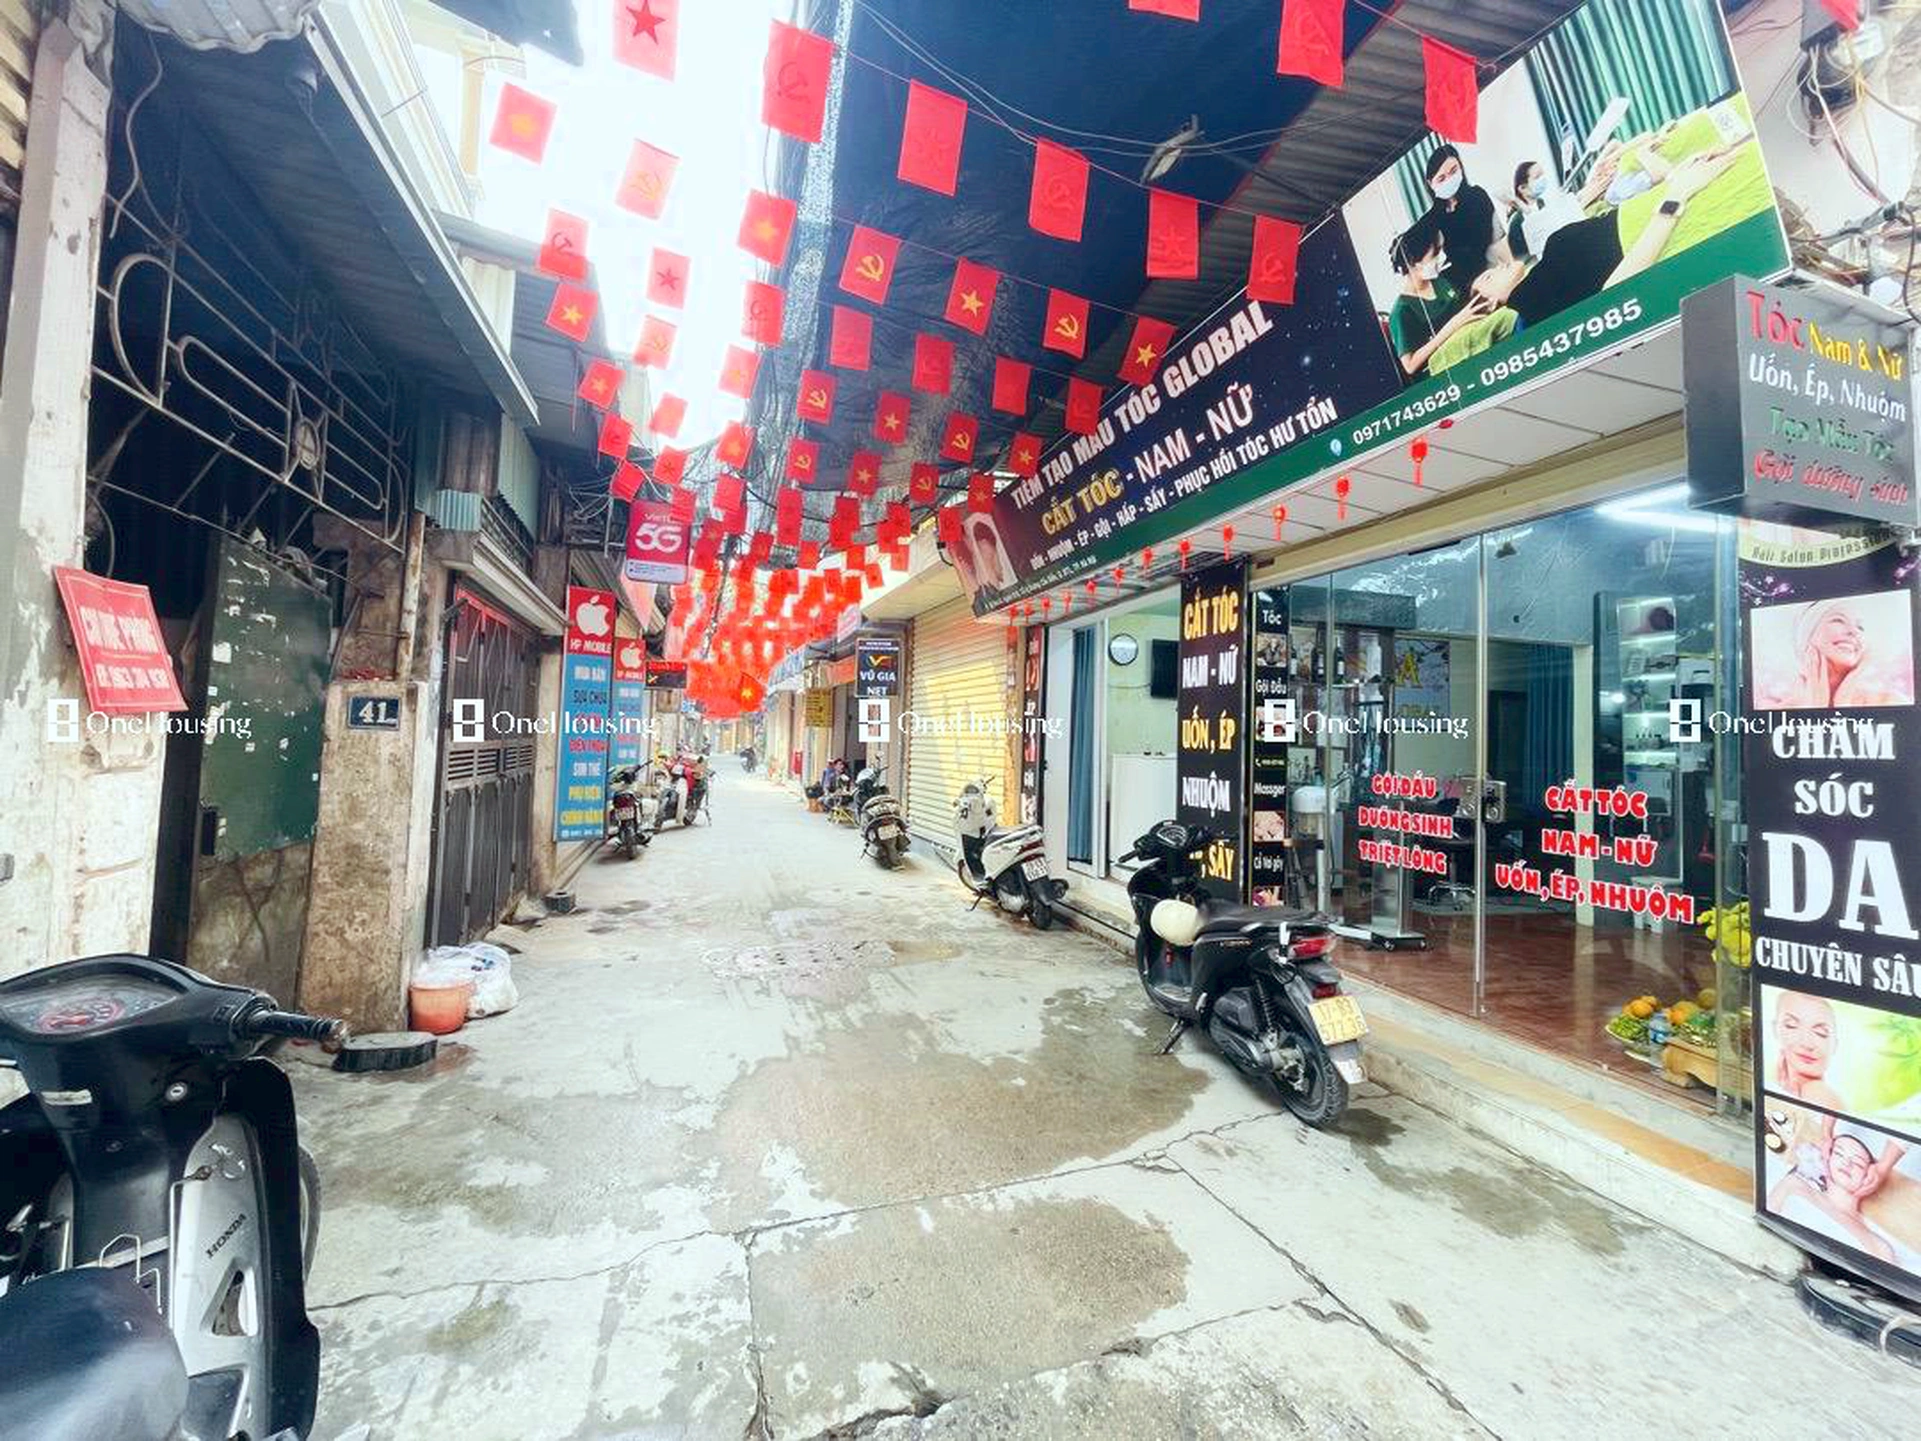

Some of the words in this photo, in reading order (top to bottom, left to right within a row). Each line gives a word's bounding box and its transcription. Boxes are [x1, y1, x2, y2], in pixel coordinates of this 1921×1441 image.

[1809, 321, 1852, 366] Nam
[1041, 451, 1073, 487] TẠO
[1114, 384, 1161, 432] TÓC
[1162, 300, 1274, 399] GLOBAL
[1352, 385, 1461, 445] 0971743629
[1480, 298, 1643, 387] 0985437985
[1077, 468, 1124, 513] TÓC
[1134, 428, 1191, 484] NAM
[1206, 381, 1254, 441] NỮ
[1174, 469, 1211, 494] PHỤC
[1236, 434, 1269, 465] TÓC
[635, 523, 682, 553] 5G
[1211, 585, 1239, 635] TÓC
[877, 671, 896, 682] GIA
[1182, 655, 1208, 689] NAM
[359, 701, 387, 723] 41
[1182, 771, 1232, 817] NHUỘM
[1596, 785, 1648, 818] TÓC
[1794, 772, 1874, 818] SÓC
[1412, 813, 1454, 839] SINH
[1542, 828, 1600, 859] NAM
[1615, 834, 1658, 867] NỮ
[1589, 882, 1695, 924] NHUỘM
[1762, 831, 1920, 940] DA
[1755, 936, 1863, 987] CHUYÊN
[206, 1213, 247, 1259] HONDA
